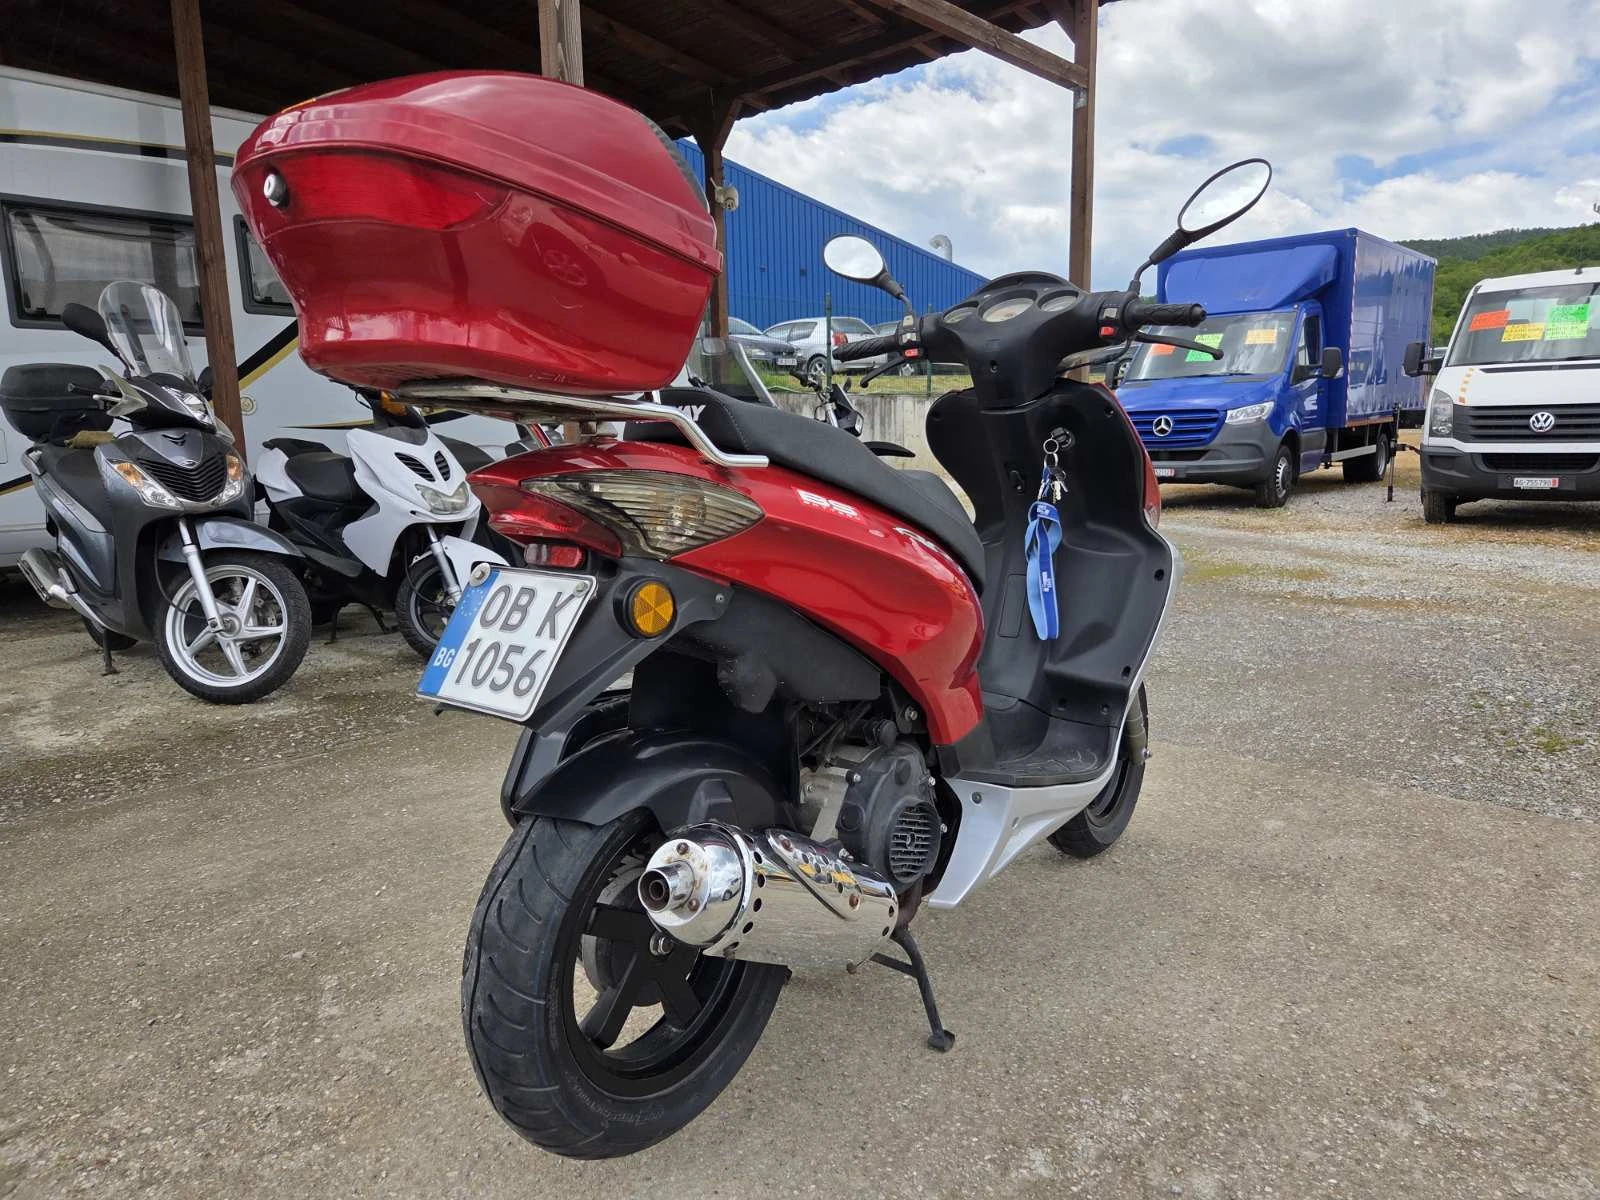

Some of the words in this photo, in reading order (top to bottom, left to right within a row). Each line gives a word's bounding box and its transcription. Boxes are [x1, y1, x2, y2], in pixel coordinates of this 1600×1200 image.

[480, 585, 536, 632] OB
[537, 592, 574, 638] K
[434, 648, 455, 667] BG
[456, 639, 546, 696] 1056
